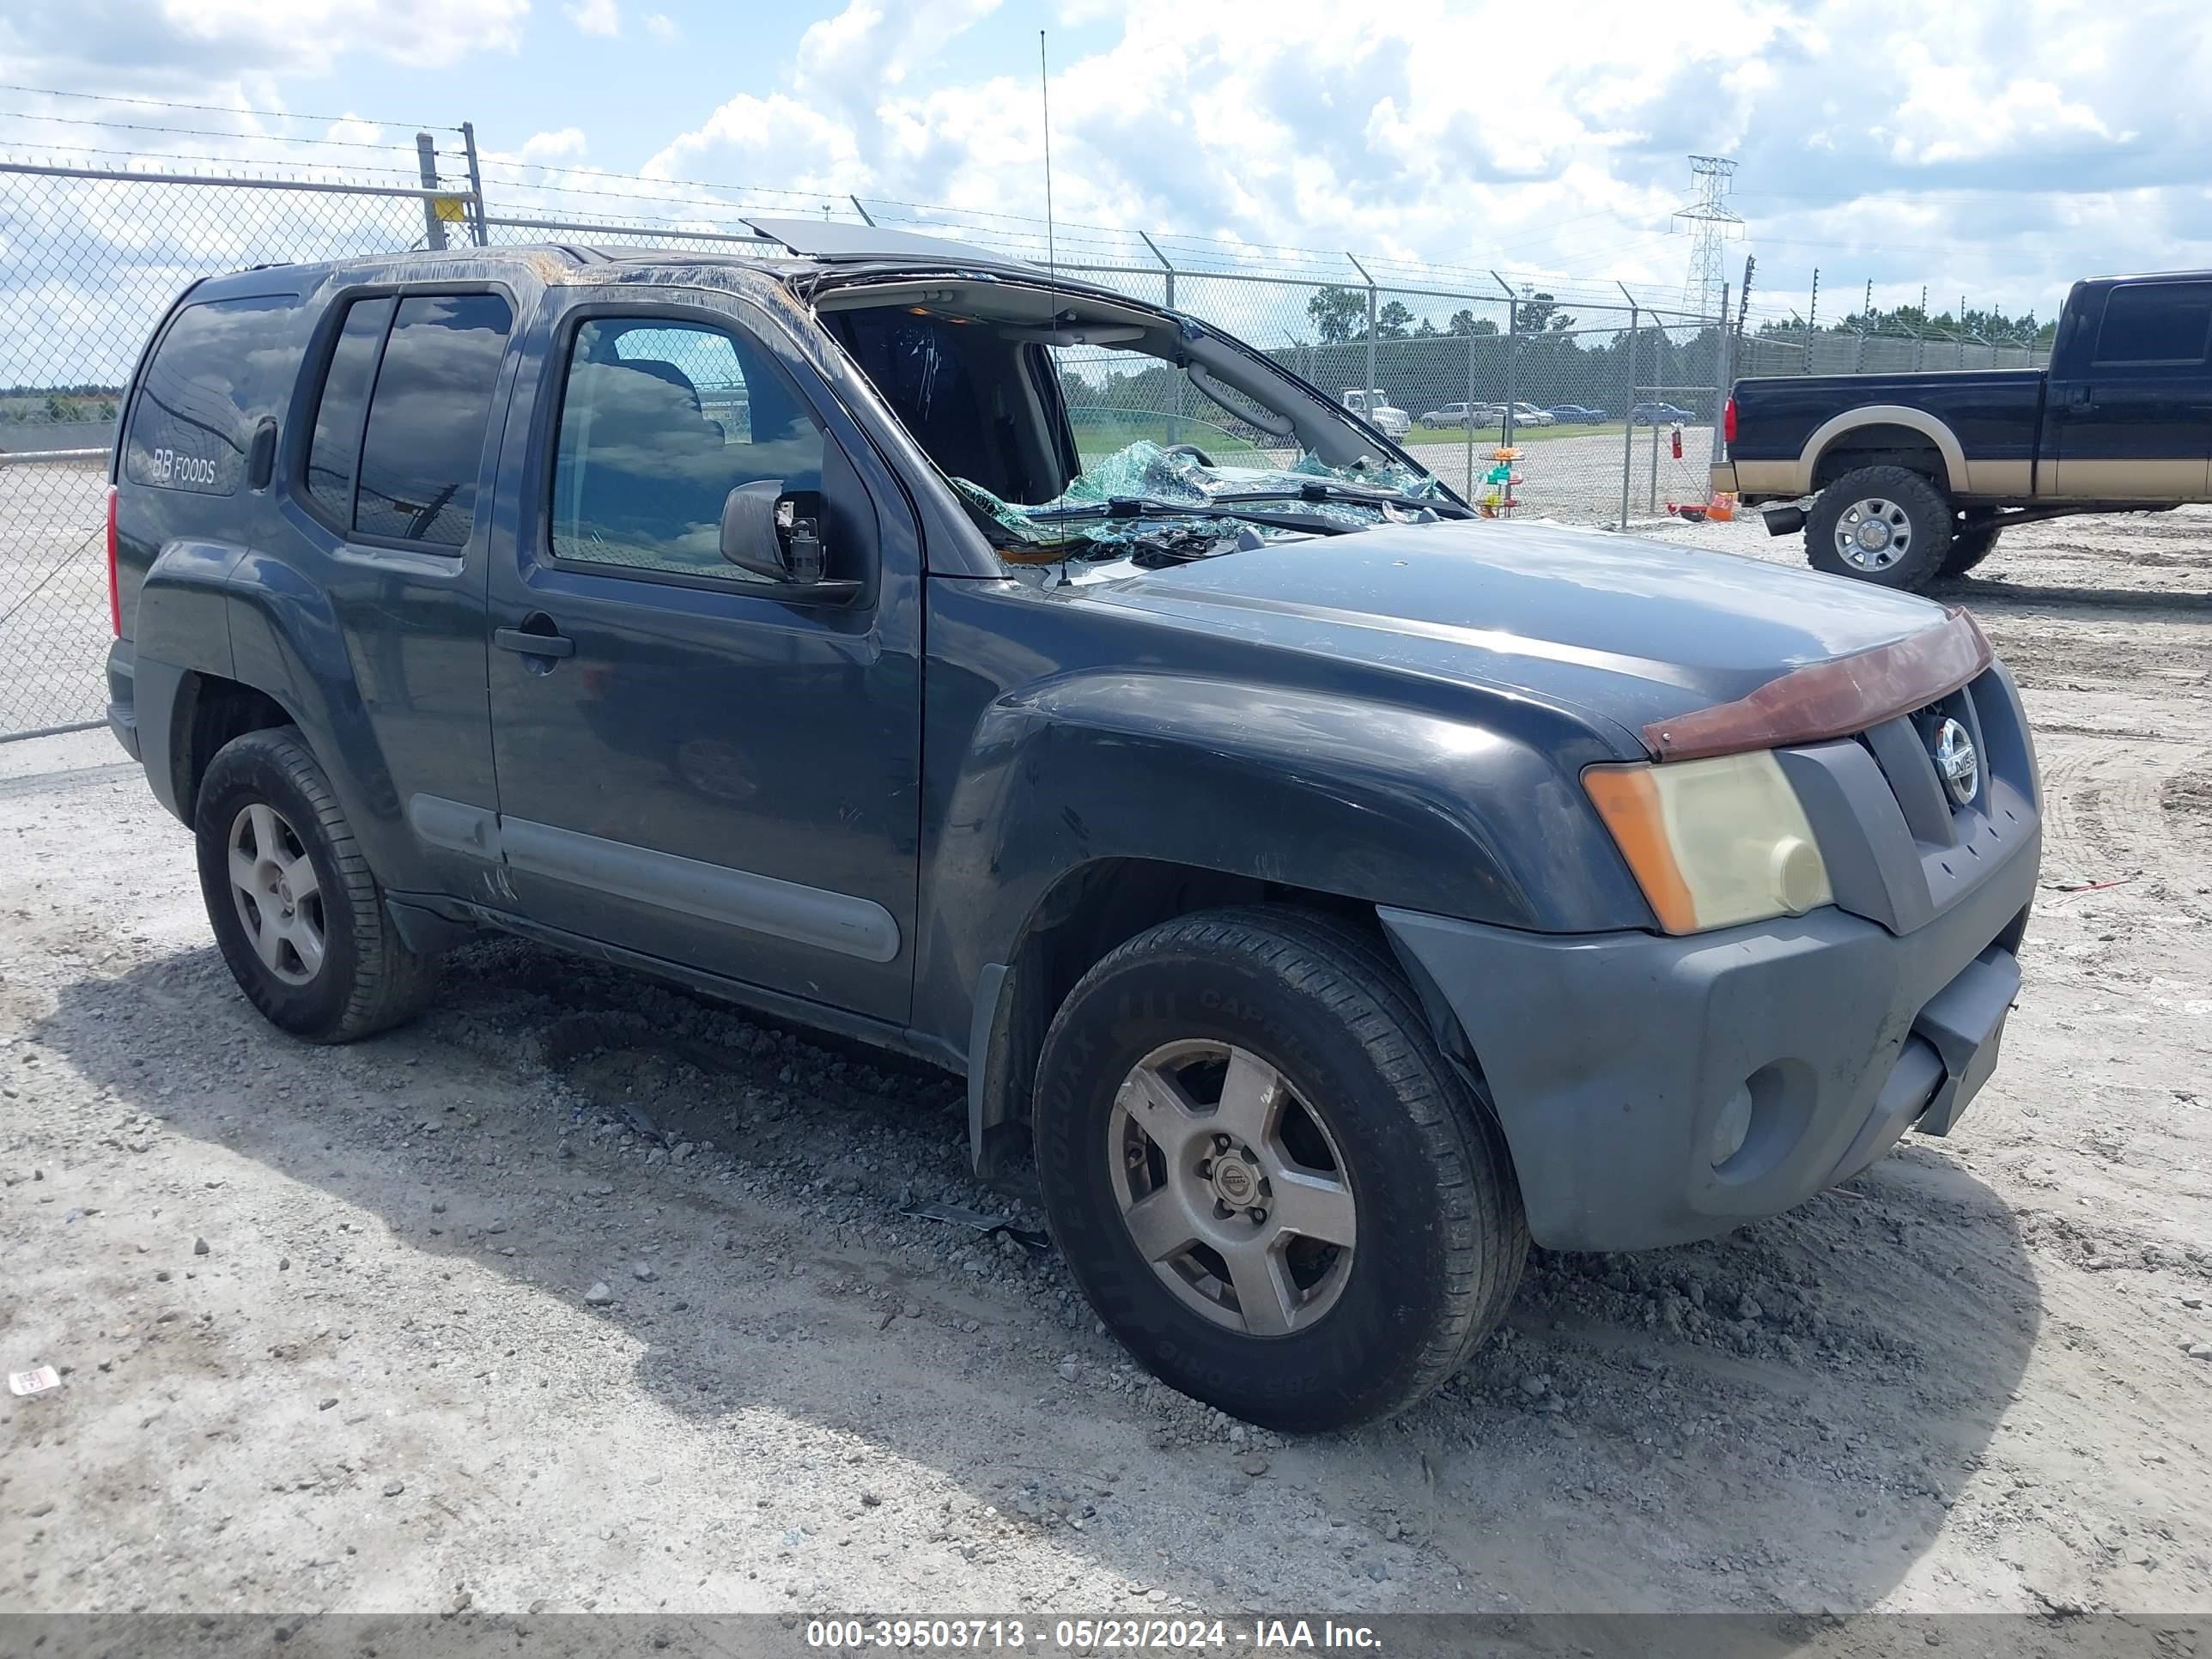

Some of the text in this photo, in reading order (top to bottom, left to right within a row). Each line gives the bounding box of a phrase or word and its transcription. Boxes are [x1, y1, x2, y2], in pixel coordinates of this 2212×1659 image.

[153, 448, 216, 484] BB FOODS
[1954, 753, 1975, 773] NISS
